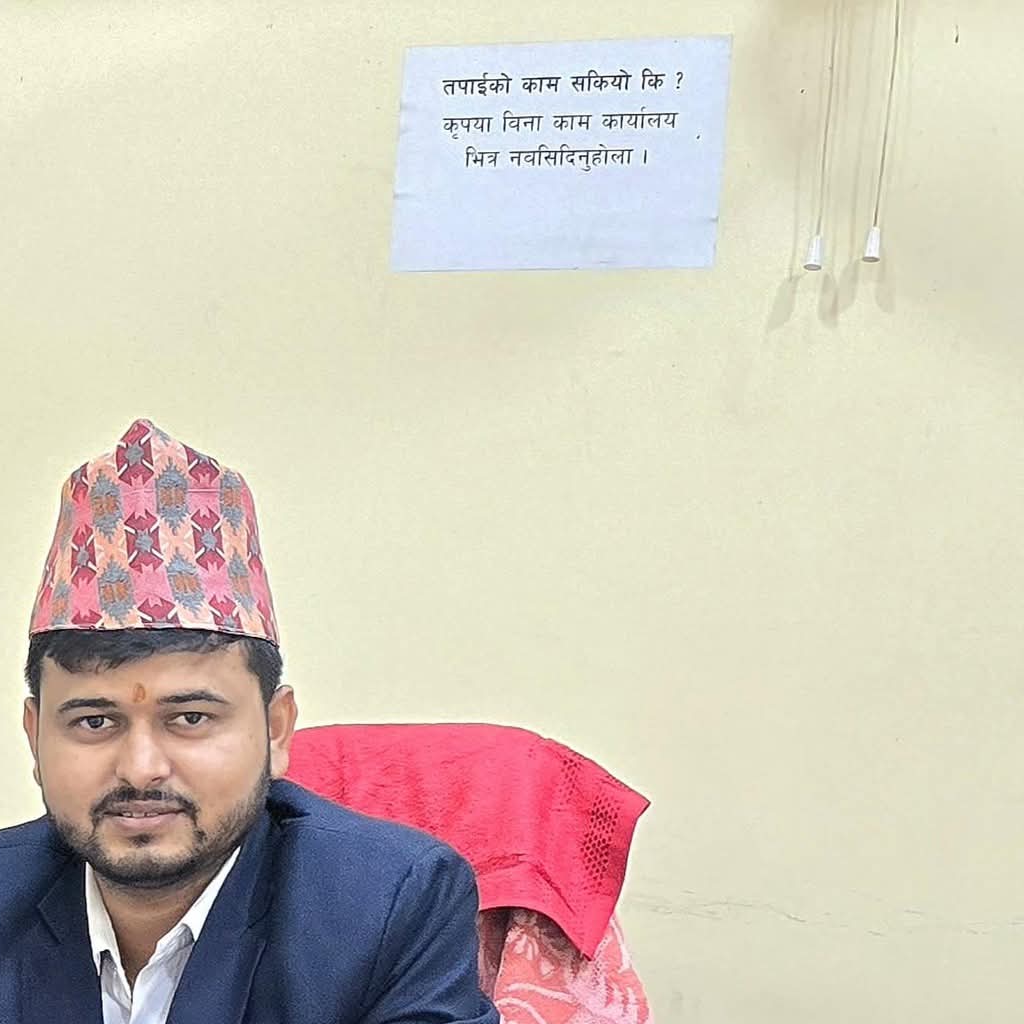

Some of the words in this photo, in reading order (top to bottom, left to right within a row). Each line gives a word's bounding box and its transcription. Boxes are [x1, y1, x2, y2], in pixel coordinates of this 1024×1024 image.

[442, 72, 513, 96] तपाईको
[522, 76, 562, 94] काम
[571, 68, 633, 93] सकियो
[641, 68, 666, 91] कि
[675, 71, 684, 91] ?
[442, 117, 494, 140] कृपया
[502, 111, 544, 133] विना
[552, 114, 593, 130] काम
[601, 106, 679, 130] कार्यालय
[465, 146, 501, 168] भित्र
[509, 144, 634, 172] नवसिदिनुहोला
